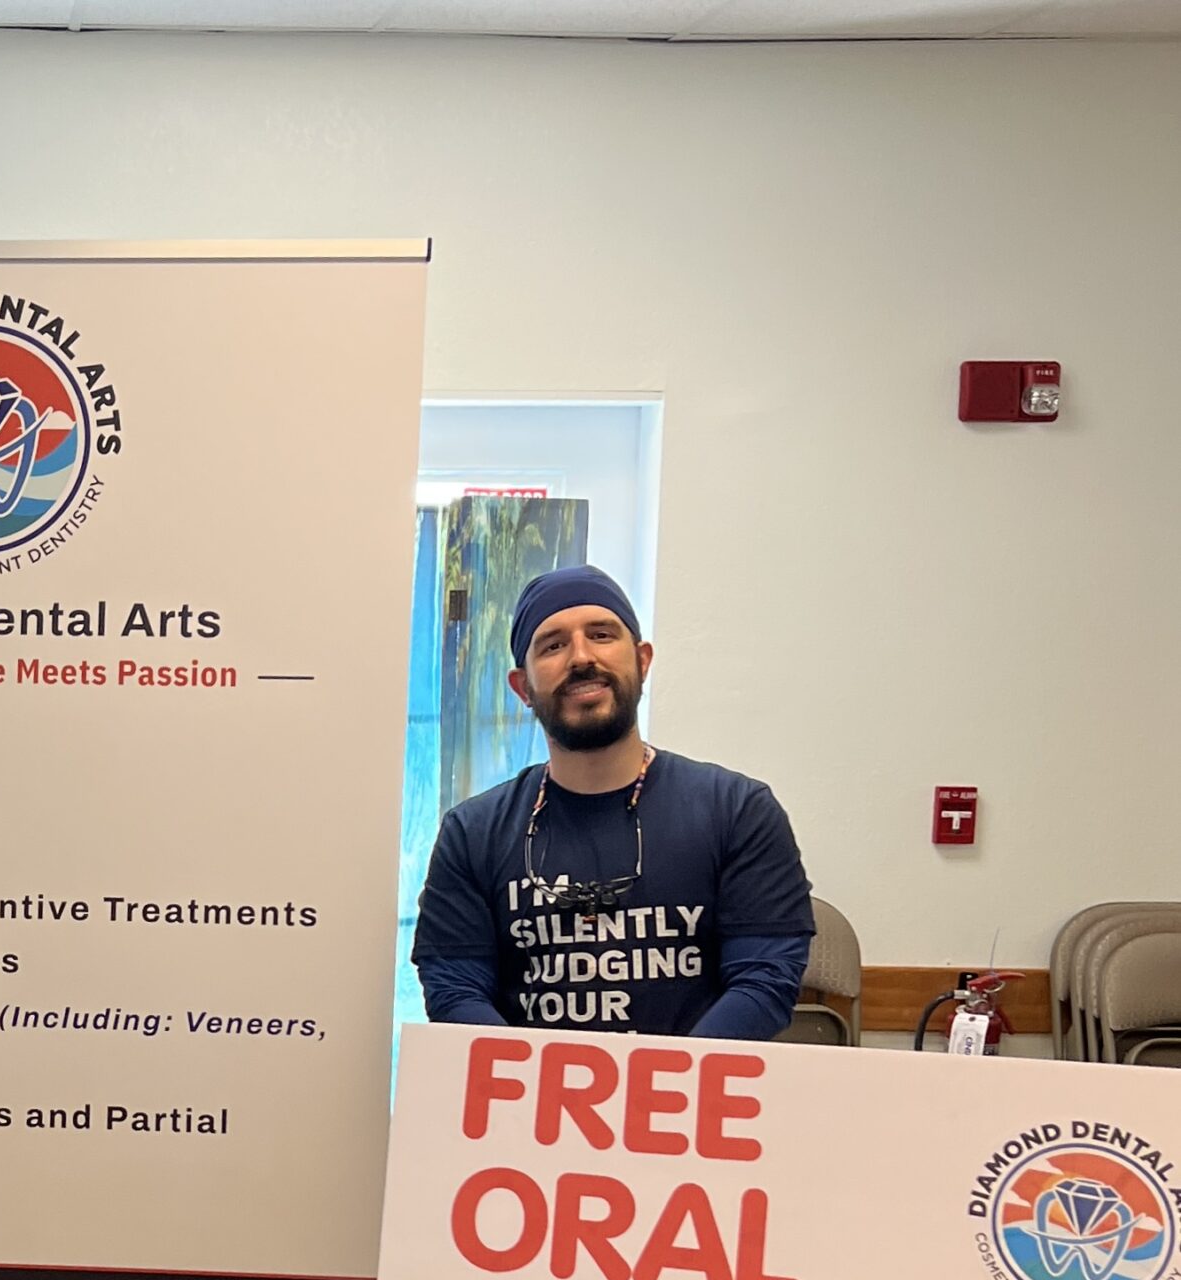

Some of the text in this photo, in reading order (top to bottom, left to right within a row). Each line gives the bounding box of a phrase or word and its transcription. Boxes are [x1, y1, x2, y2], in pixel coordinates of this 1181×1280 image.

[77, 363, 122, 455] ARTS
[28, 475, 105, 563] DENTISTRY
[121, 601, 222, 638] Arts
[15, 658, 107, 686] Meets
[117, 660, 238, 689] Passion
[508, 874, 569, 911] I'M
[104, 896, 318, 928] Treatments
[510, 905, 704, 948] SILENTLY
[523, 945, 702, 984] JUDGING
[519, 990, 631, 1023] YOUR
[186, 1010, 327, 1042] Veneers,
[462, 1037, 766, 1162] FREE
[25, 1102, 92, 1130] and
[105, 1105, 229, 1135] Partial
[968, 1120, 1174, 1218] DIAMOND DENTAL
